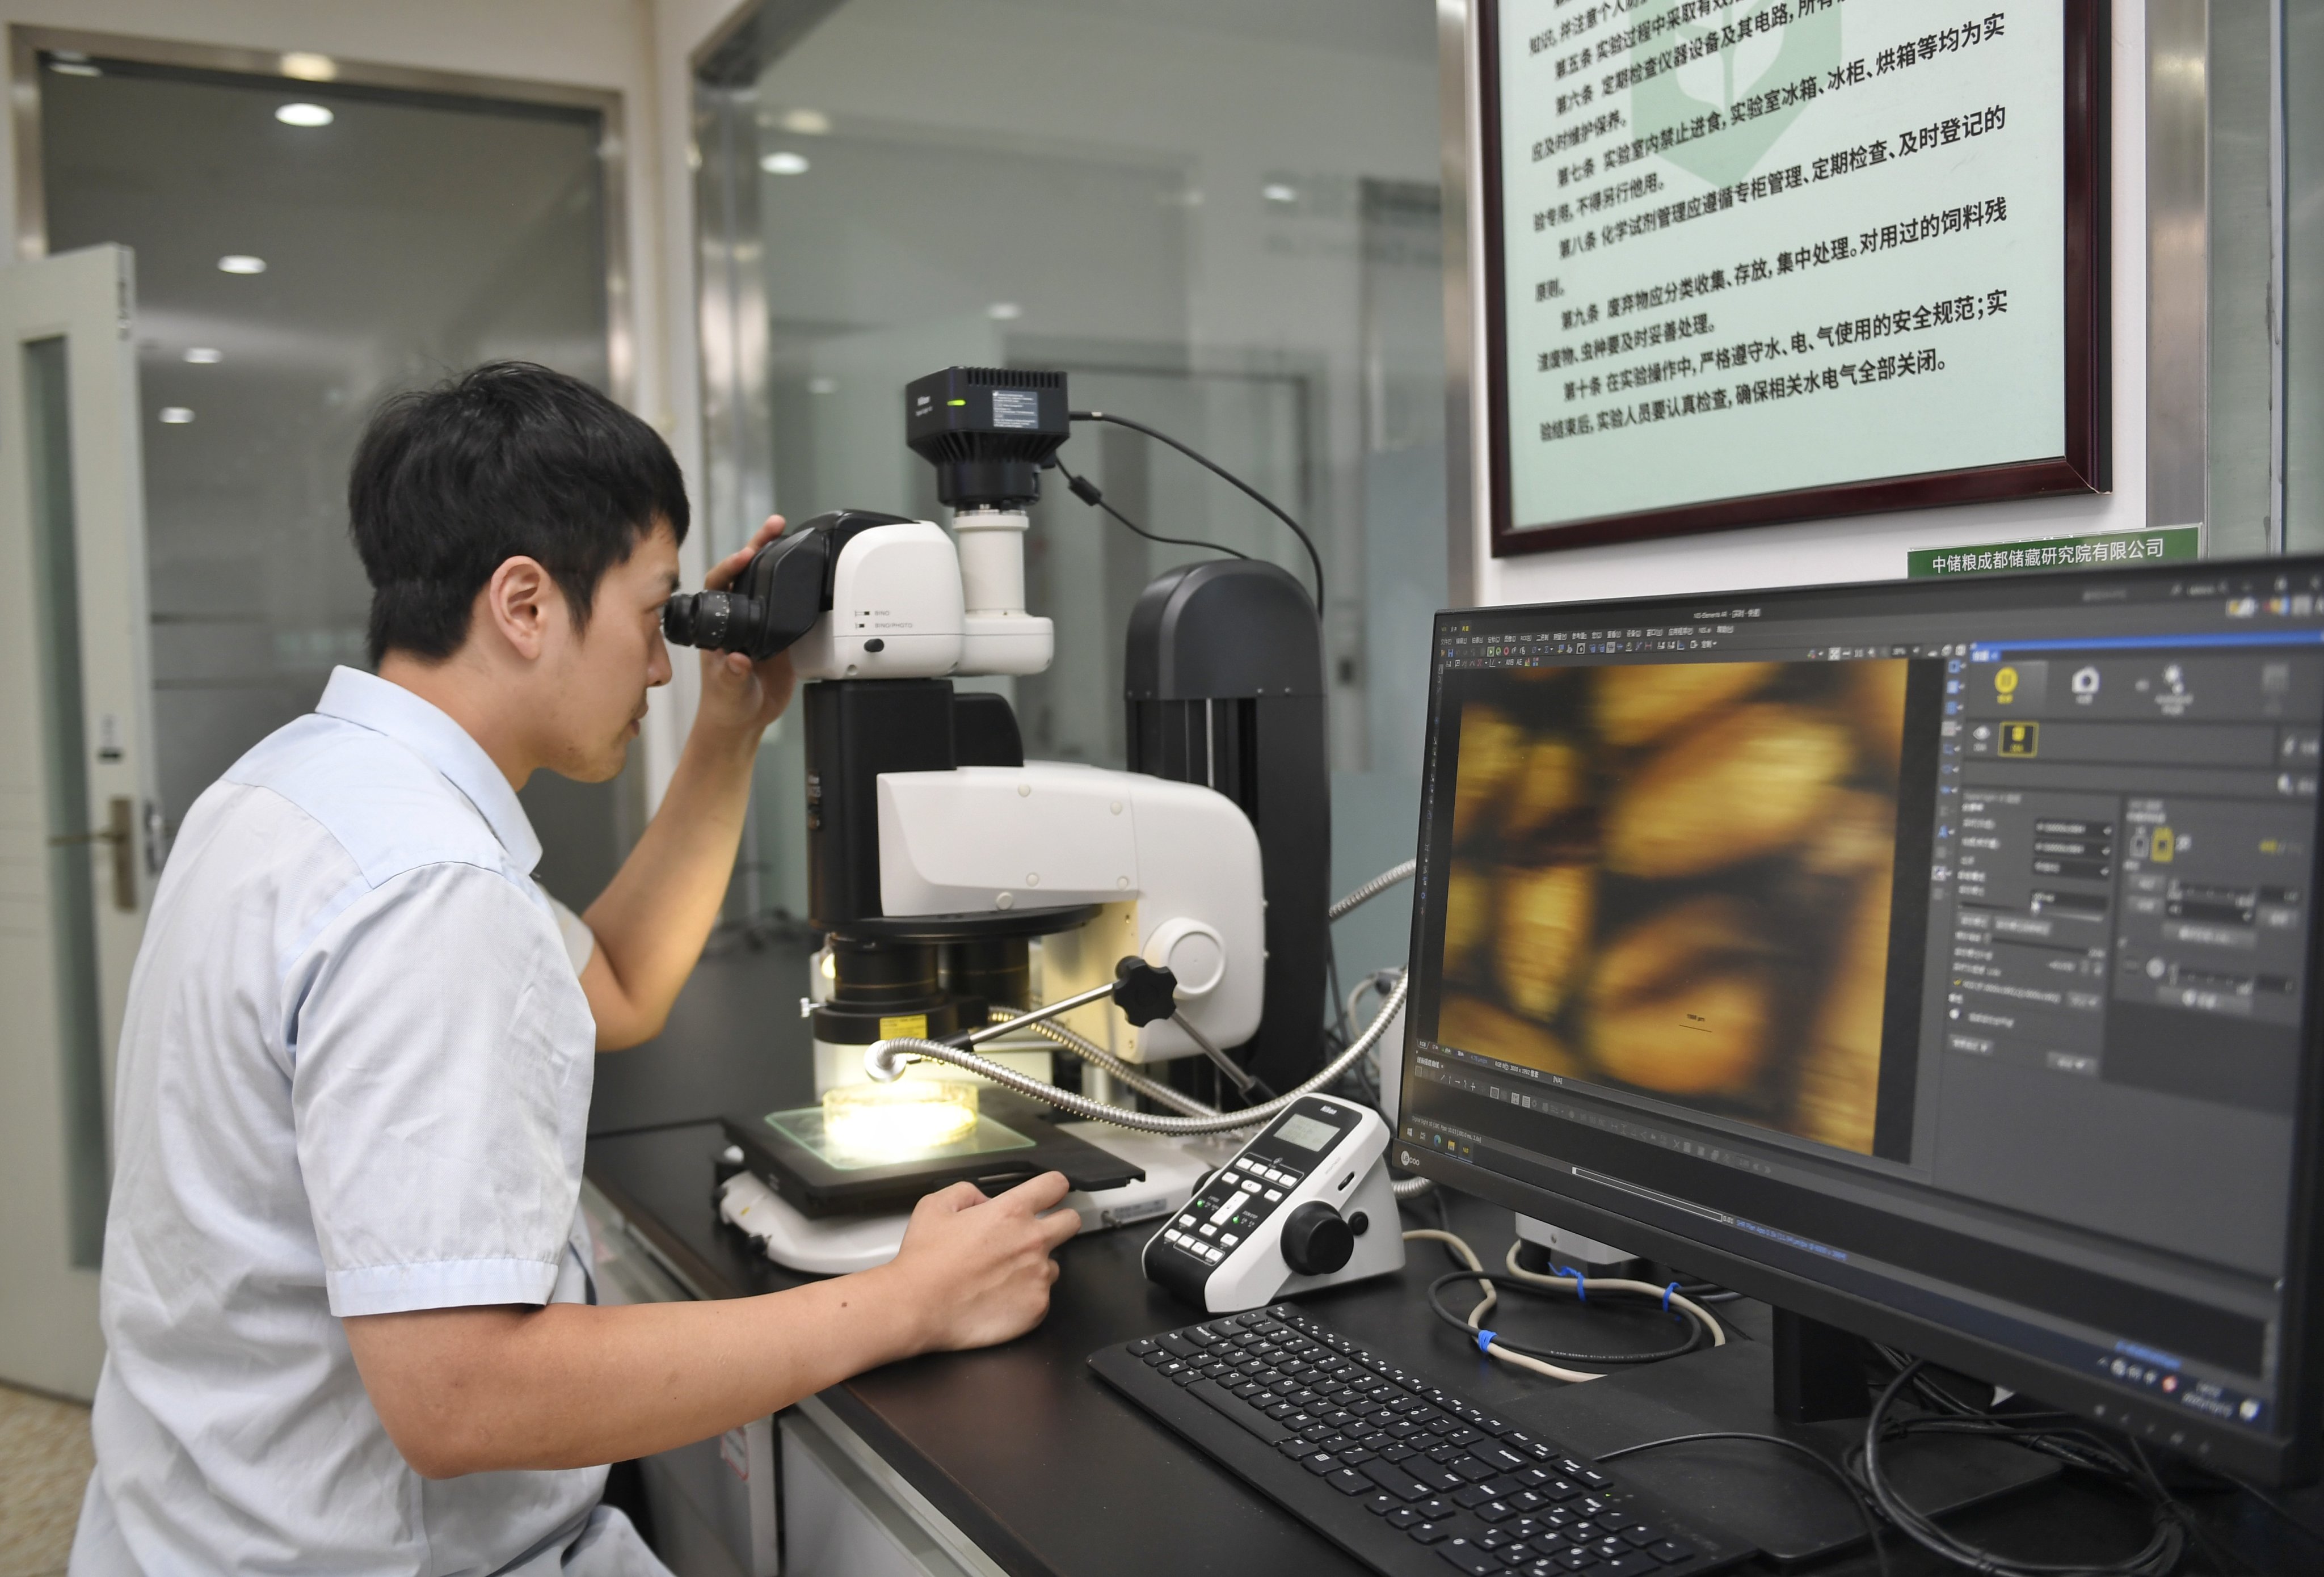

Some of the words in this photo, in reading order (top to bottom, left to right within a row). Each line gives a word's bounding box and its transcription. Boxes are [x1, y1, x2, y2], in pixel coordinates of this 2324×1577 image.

[1933, 538, 2163, 574] 中储粮成都储藏研究院有限公司
[1320, 1105, 1337, 1115] Nikon
[1401, 1150, 1420, 1166] Lecoo
